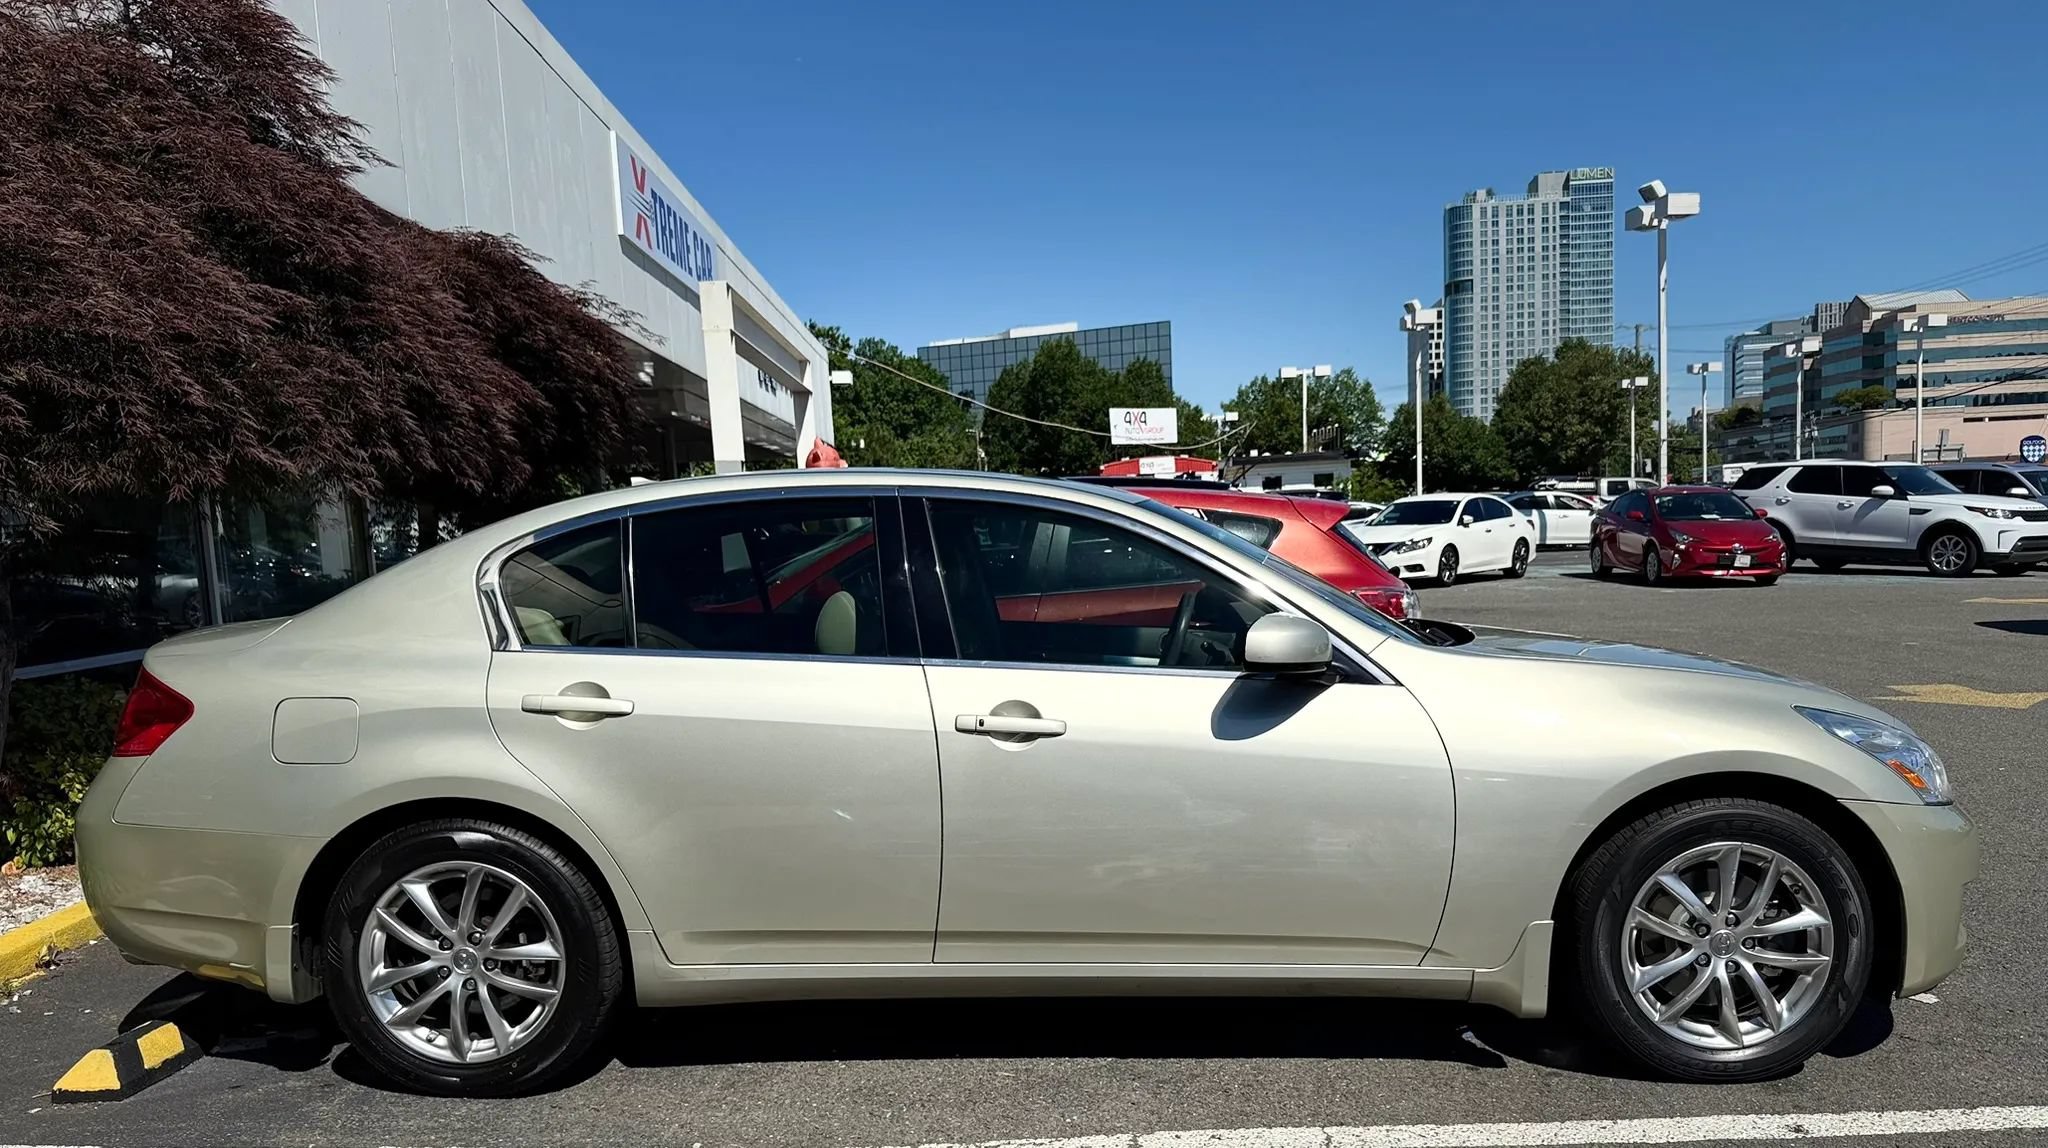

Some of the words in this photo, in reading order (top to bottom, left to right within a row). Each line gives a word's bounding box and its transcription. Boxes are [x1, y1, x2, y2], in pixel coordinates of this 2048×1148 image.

[1570, 167, 1614, 179] LUMEN
[630, 154, 693, 278] XTREME
[693, 230, 714, 281] CAR
